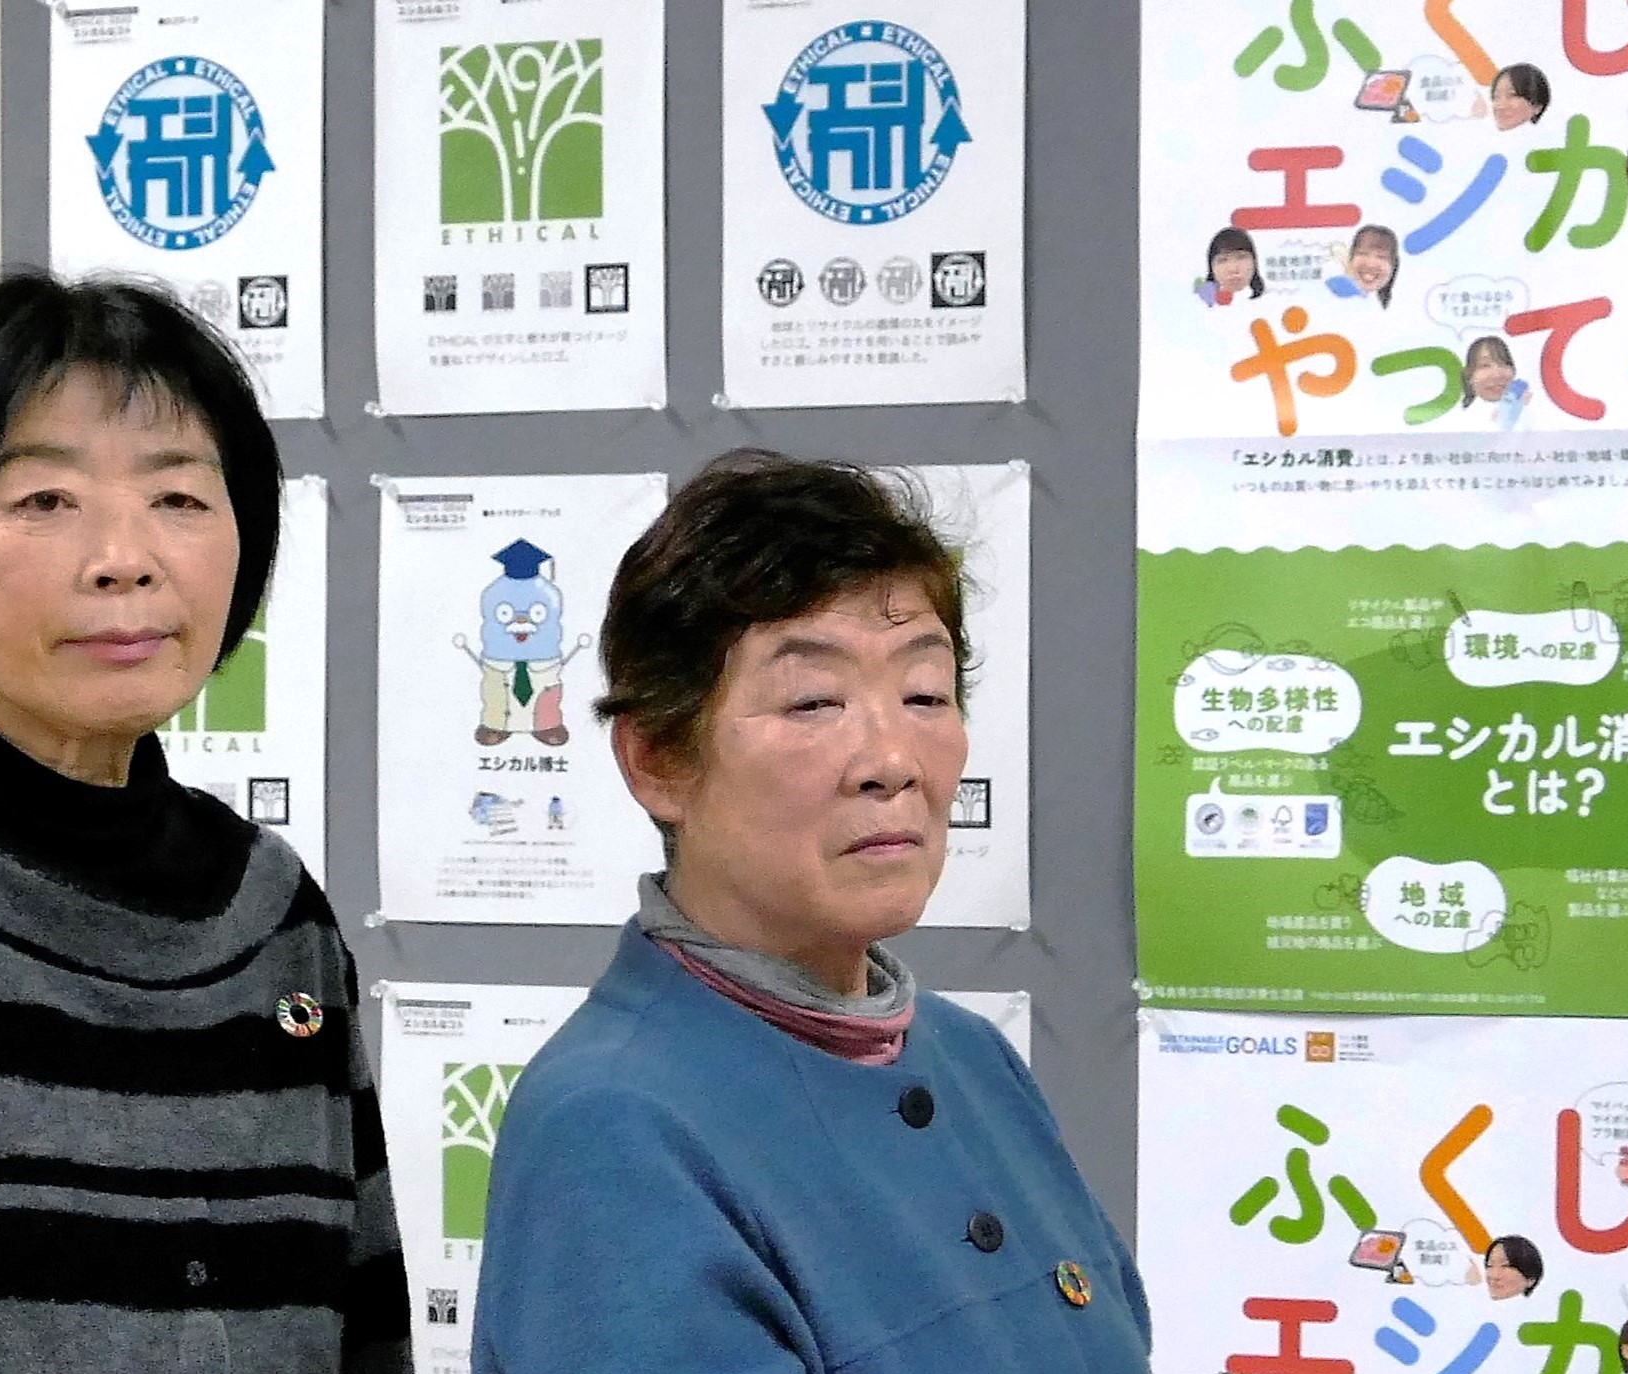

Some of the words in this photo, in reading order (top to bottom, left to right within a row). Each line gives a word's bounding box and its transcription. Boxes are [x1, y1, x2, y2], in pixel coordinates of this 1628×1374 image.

[441, 224, 600, 245] ETHICAL
[1464, 632, 1597, 661] 環境への配慮
[1200, 686, 1338, 713] 生物多様性
[1228, 716, 1304, 733] への配慮
[478, 755, 569, 773] エシカル博士
[1481, 768, 1606, 818] とは？
[1400, 881, 1465, 907] 地域
[1394, 910, 1471, 928] への配慮
[1226, 1036, 1298, 1055] GOALS
